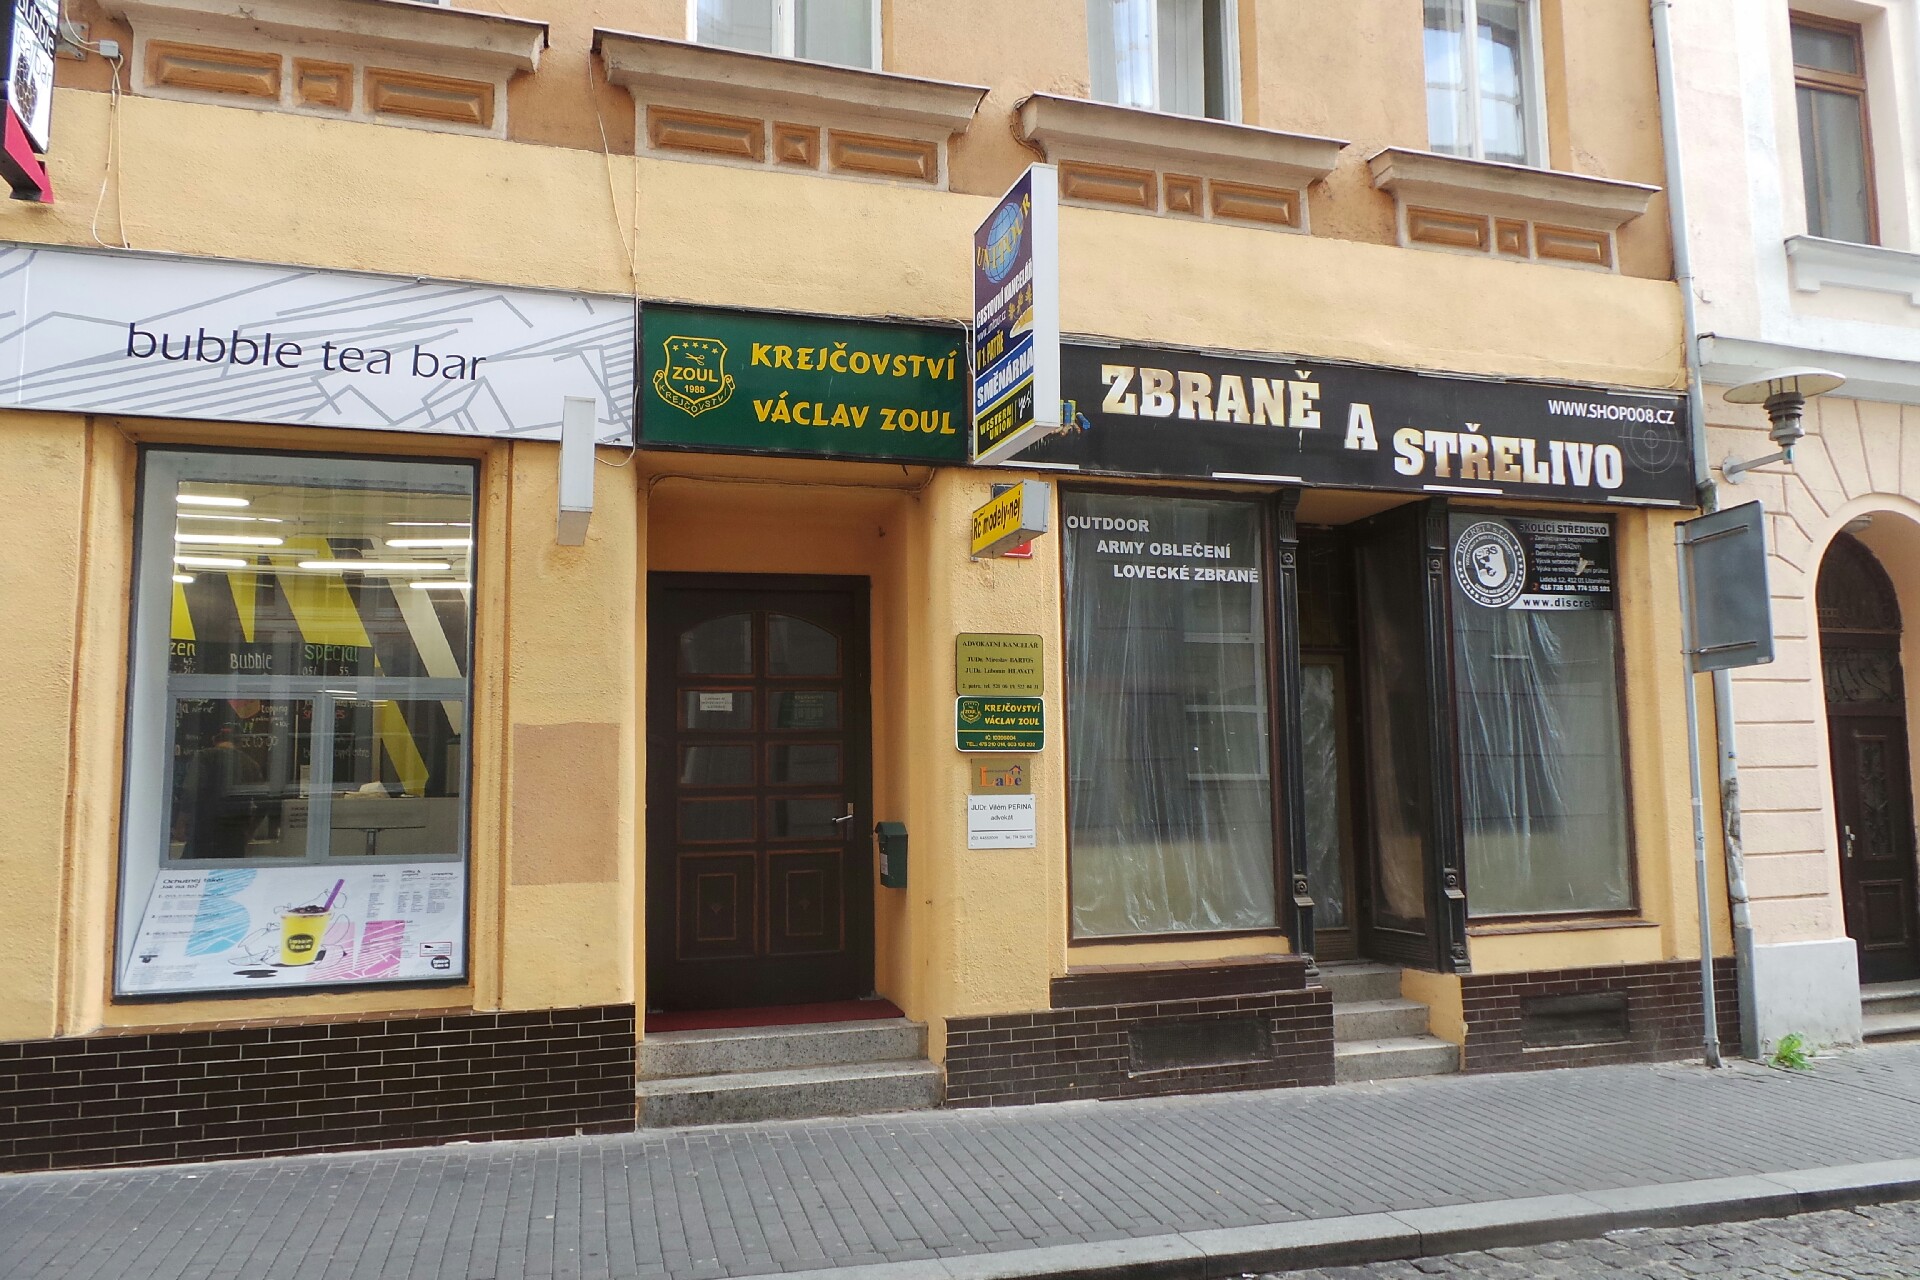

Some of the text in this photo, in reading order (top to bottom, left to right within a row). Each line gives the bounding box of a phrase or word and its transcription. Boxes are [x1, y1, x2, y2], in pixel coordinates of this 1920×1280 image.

[977, 257, 1033, 329] CESTOVNÍ KANCELÁŘ
[127, 322, 487, 381] bubble tea bar
[986, 329, 1004, 362] PATŘE
[672, 366, 719, 382] ZOUL
[751, 341, 957, 380] KREJČOVSTVÍ
[684, 384, 706, 394] 1988
[977, 345, 1034, 408] SMĚNÁRNA
[1101, 364, 1321, 430] ZBRANĚ
[753, 390, 956, 434] VÁCLAV ZOUL
[980, 403, 1012, 436] WESTERN
[1344, 402, 1378, 450] A
[1548, 399, 1675, 425] WWW.SHOP008.CZ
[989, 415, 1013, 440] UNION
[1393, 422, 1623, 489] STŘELIVO
[1066, 515, 1150, 533] OUTDOOR
[1097, 540, 1231, 559] ARMY OBLEČENÍ
[1113, 564, 1259, 583] LOVECKÉ ZBRANĚ
[230, 652, 273, 670] Bubble
[984, 702, 1041, 713] KREJČOVSTVÍ
[984, 714, 1040, 726] VÁCLAV ZOUL
